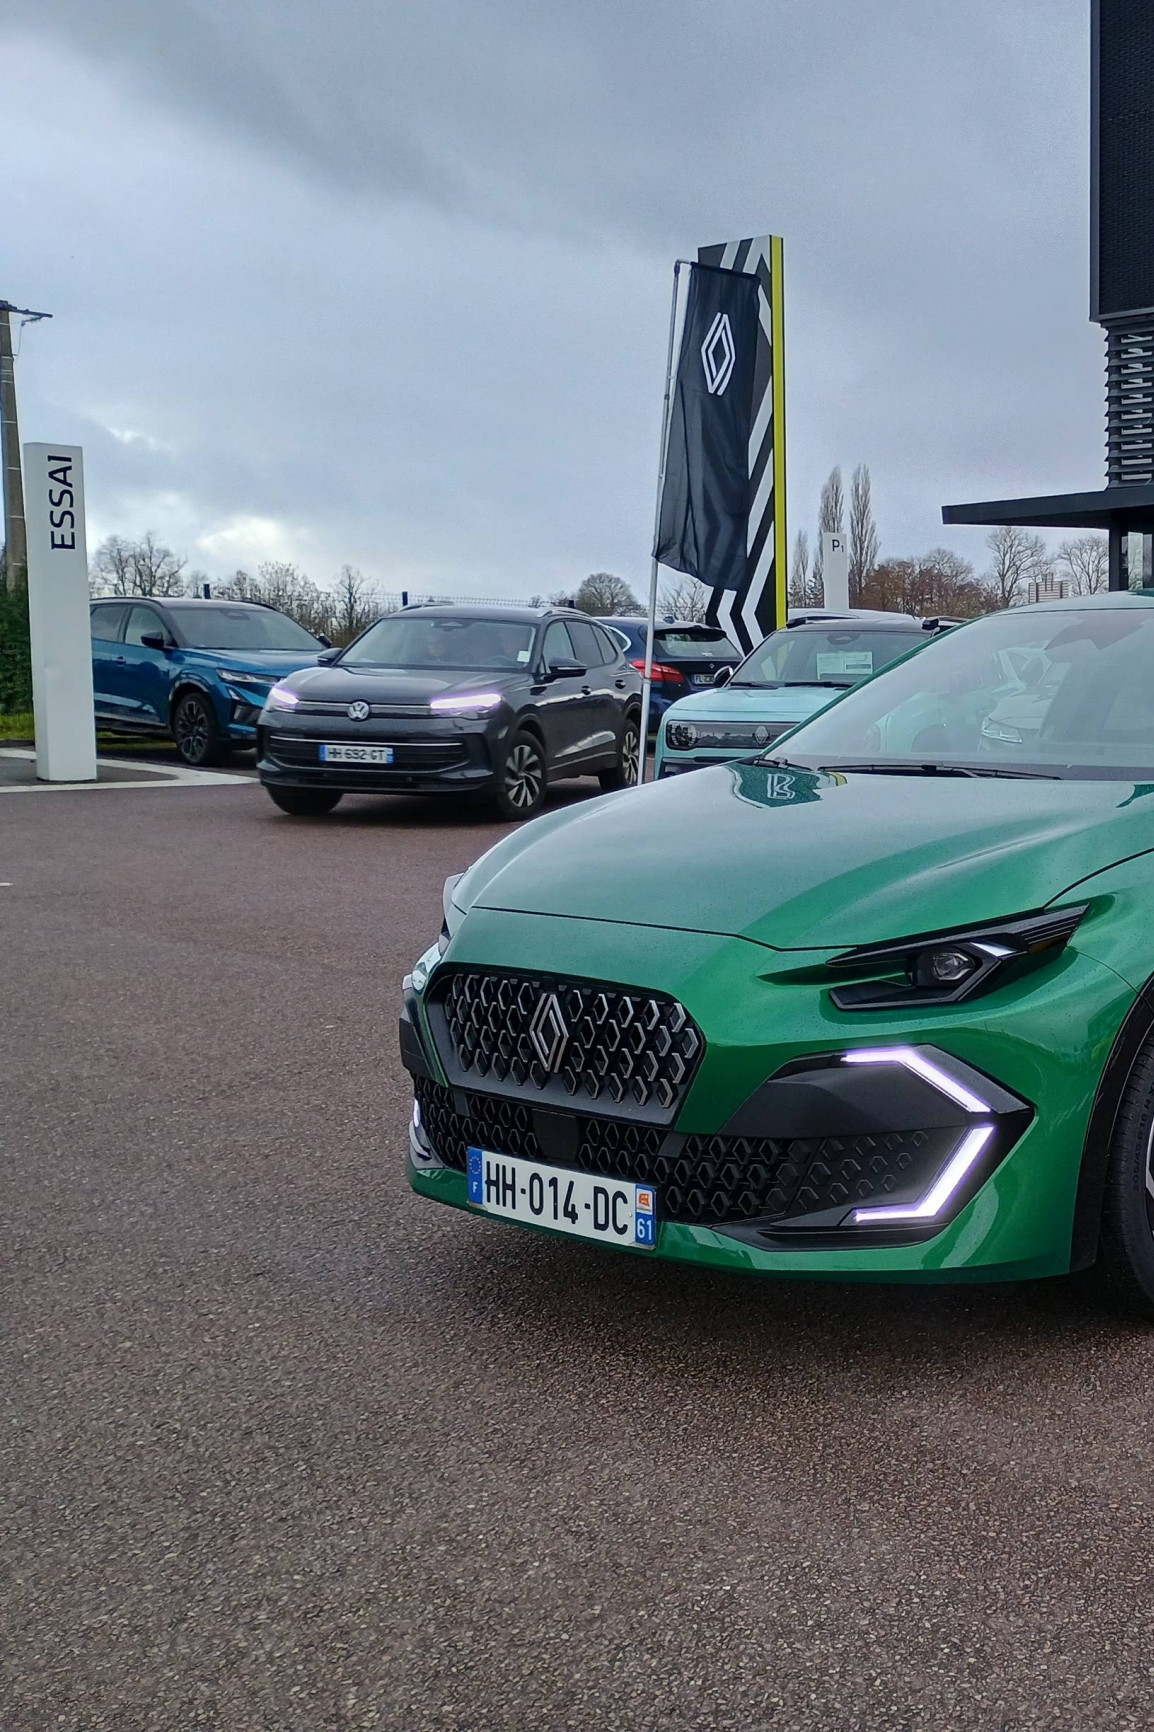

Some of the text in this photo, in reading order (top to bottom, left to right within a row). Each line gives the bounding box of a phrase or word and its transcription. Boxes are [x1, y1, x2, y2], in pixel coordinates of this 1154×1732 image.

[47, 454, 76, 550] ESSAI
[472, 1181, 478, 1193] F
[485, 1160, 628, 1235] HH-014-DC
[637, 1218, 652, 1240] 61
